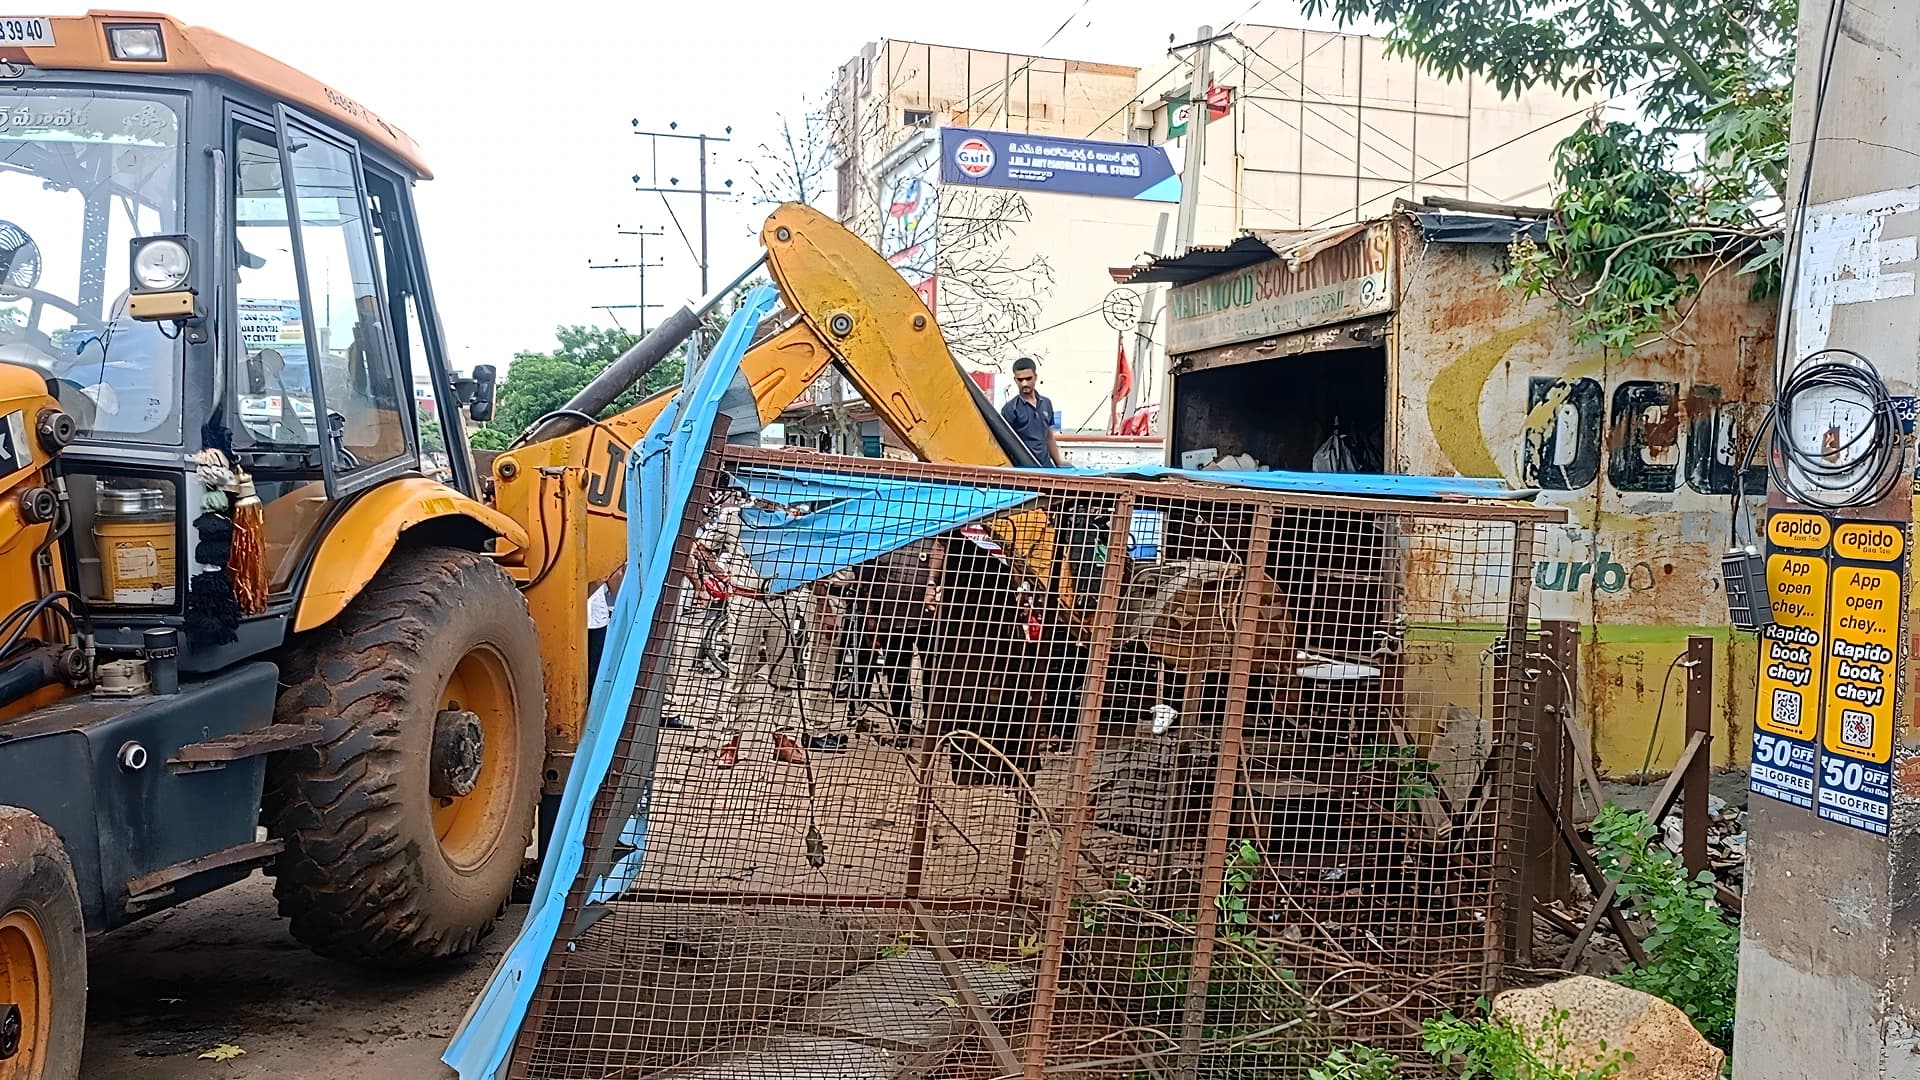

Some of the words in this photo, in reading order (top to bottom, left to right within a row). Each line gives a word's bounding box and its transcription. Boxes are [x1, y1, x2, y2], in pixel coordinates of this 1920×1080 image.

[959, 151, 990, 163] Gulf
[588, 440, 627, 512] J
[1775, 518, 1822, 537] rapido
[1842, 530, 1893, 550] rapido
[1782, 559, 1810, 577] App
[1778, 582, 1811, 595] open
[1850, 572, 1881, 591] App
[1845, 596, 1883, 611] open
[1766, 624, 1818, 645] Rapido
[1771, 645, 1810, 664] book
[1833, 640, 1891, 662] Rapido
[1768, 664, 1811, 686] chey!
[1839, 661, 1883, 683] book
[1836, 683, 1883, 706] chey!
[1791, 747, 1814, 763] OFF
[1863, 770, 1889, 785] OFF
